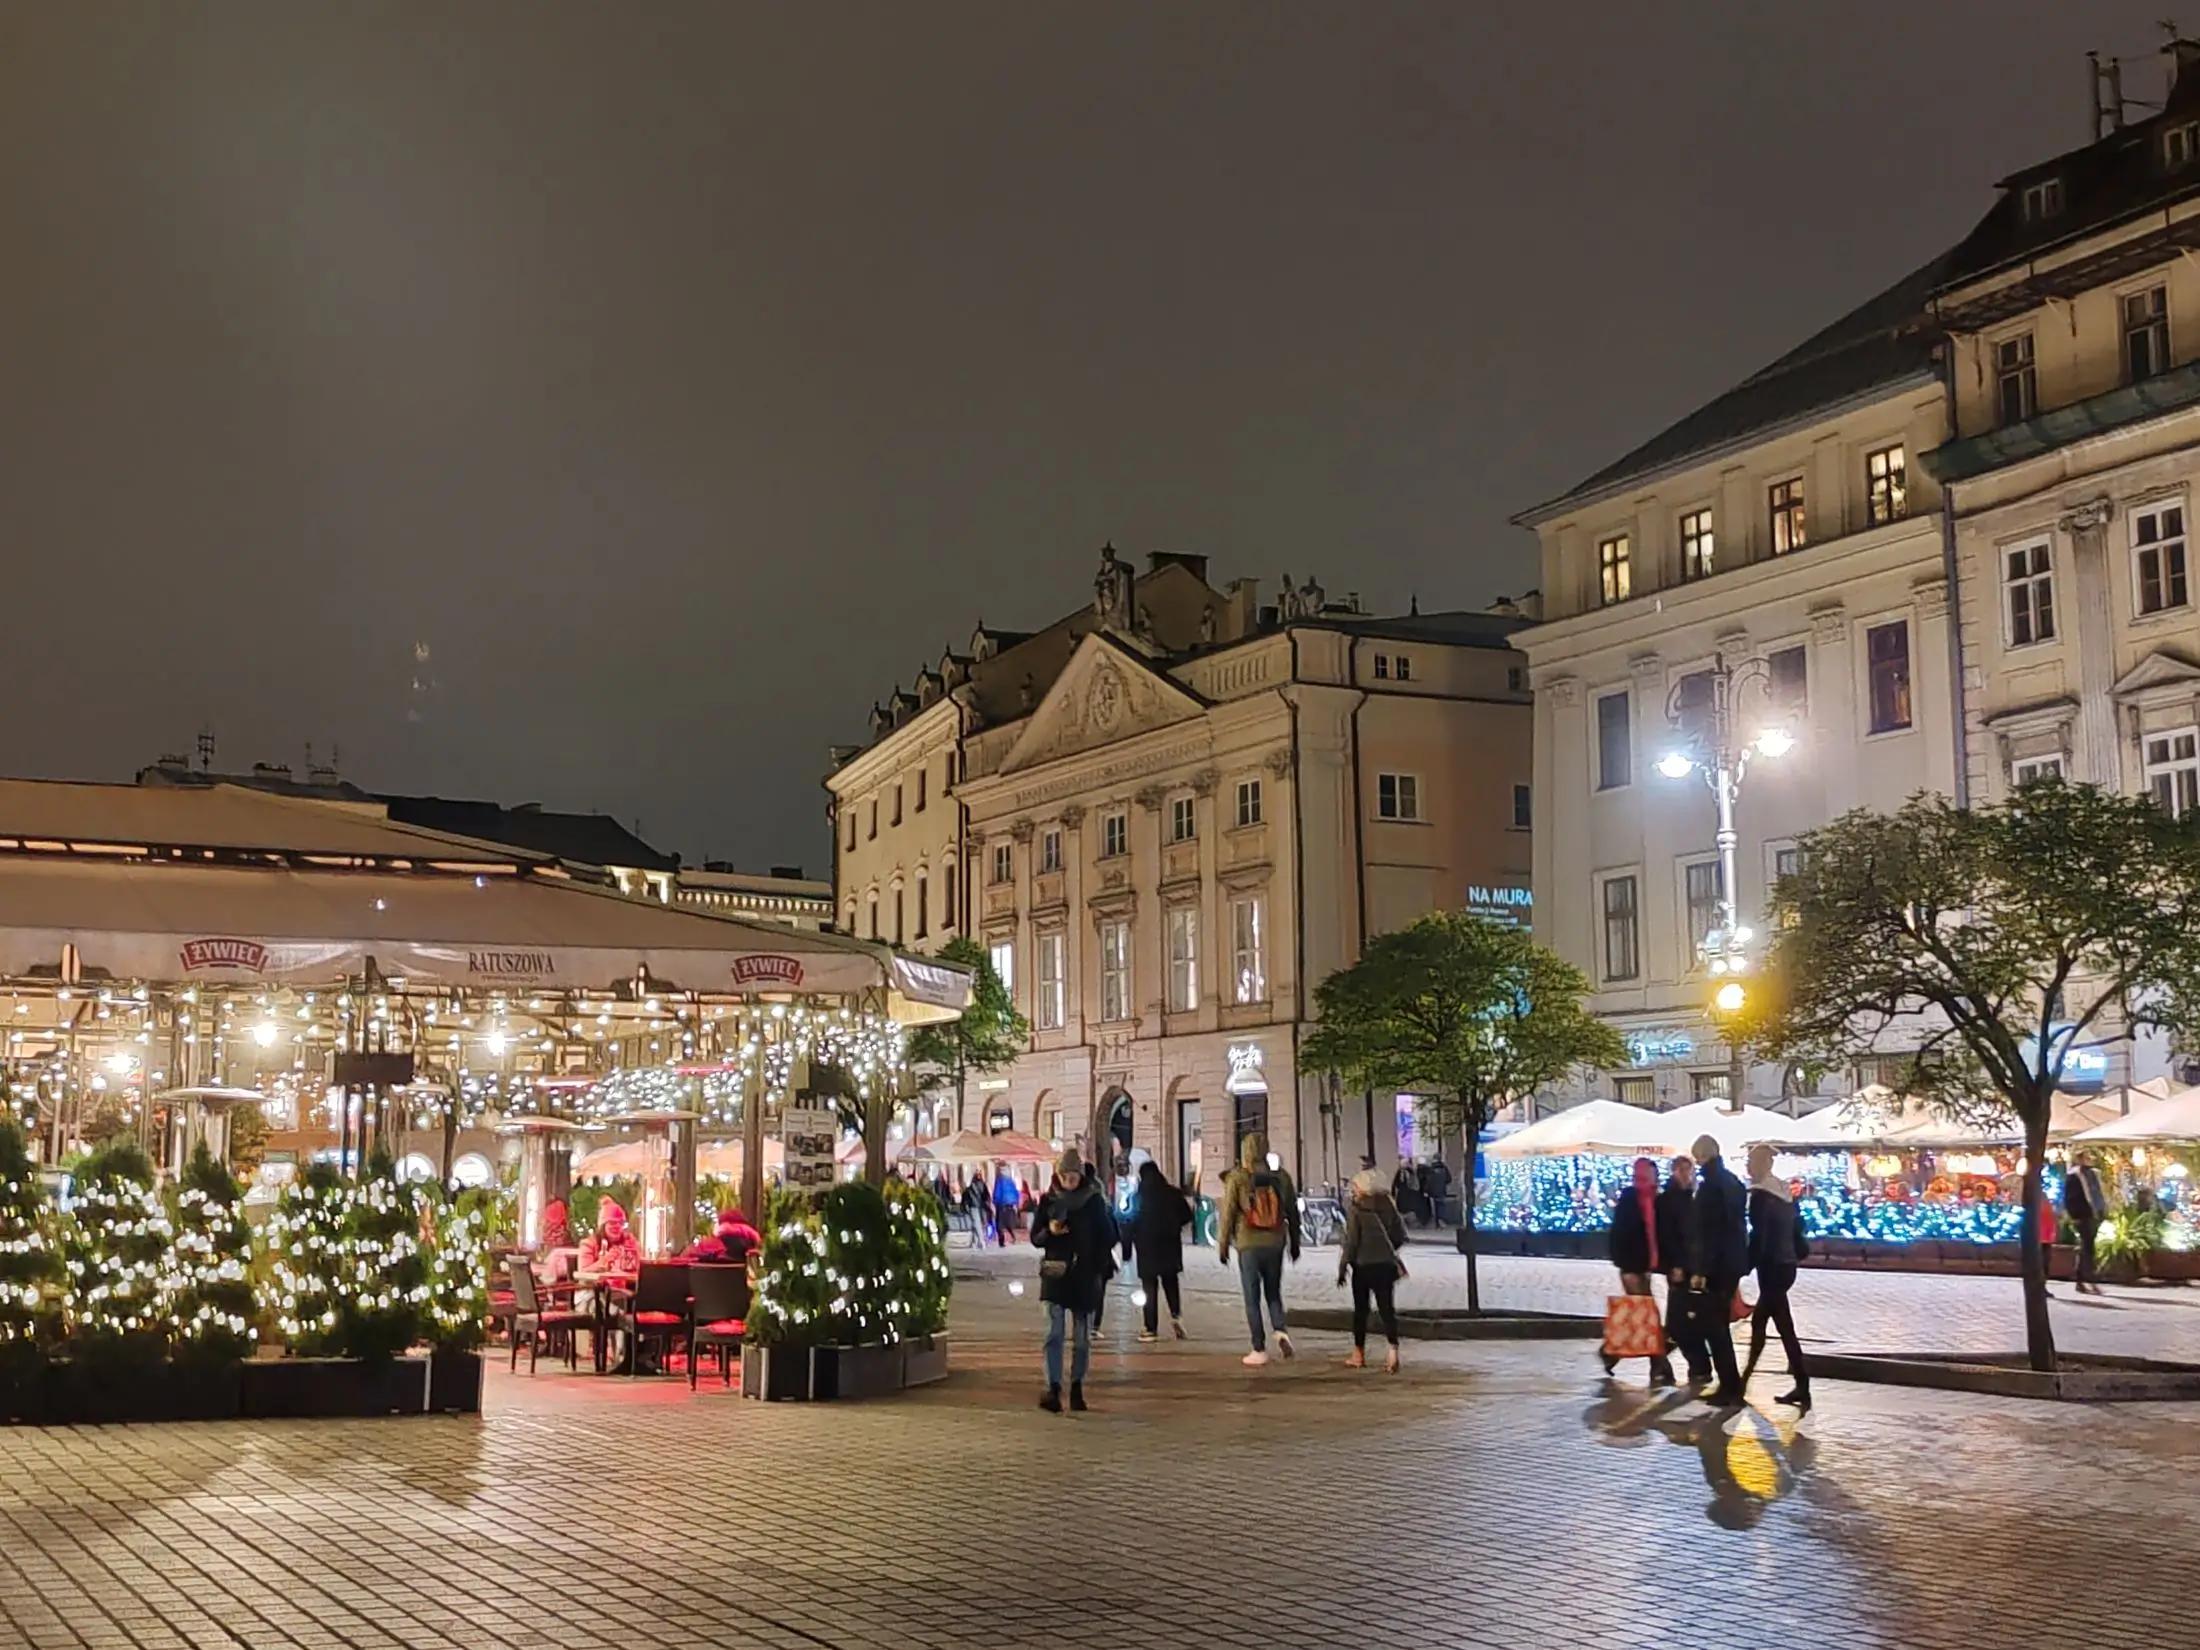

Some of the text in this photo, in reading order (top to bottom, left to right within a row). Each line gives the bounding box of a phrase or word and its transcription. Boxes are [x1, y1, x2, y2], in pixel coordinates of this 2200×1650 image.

[1468, 886, 1533, 906] NA MURA
[190, 941, 259, 963] ŻYWIEC
[468, 951, 555, 974] RATUSZOWA
[739, 957, 796, 977] ŻYWIEC
